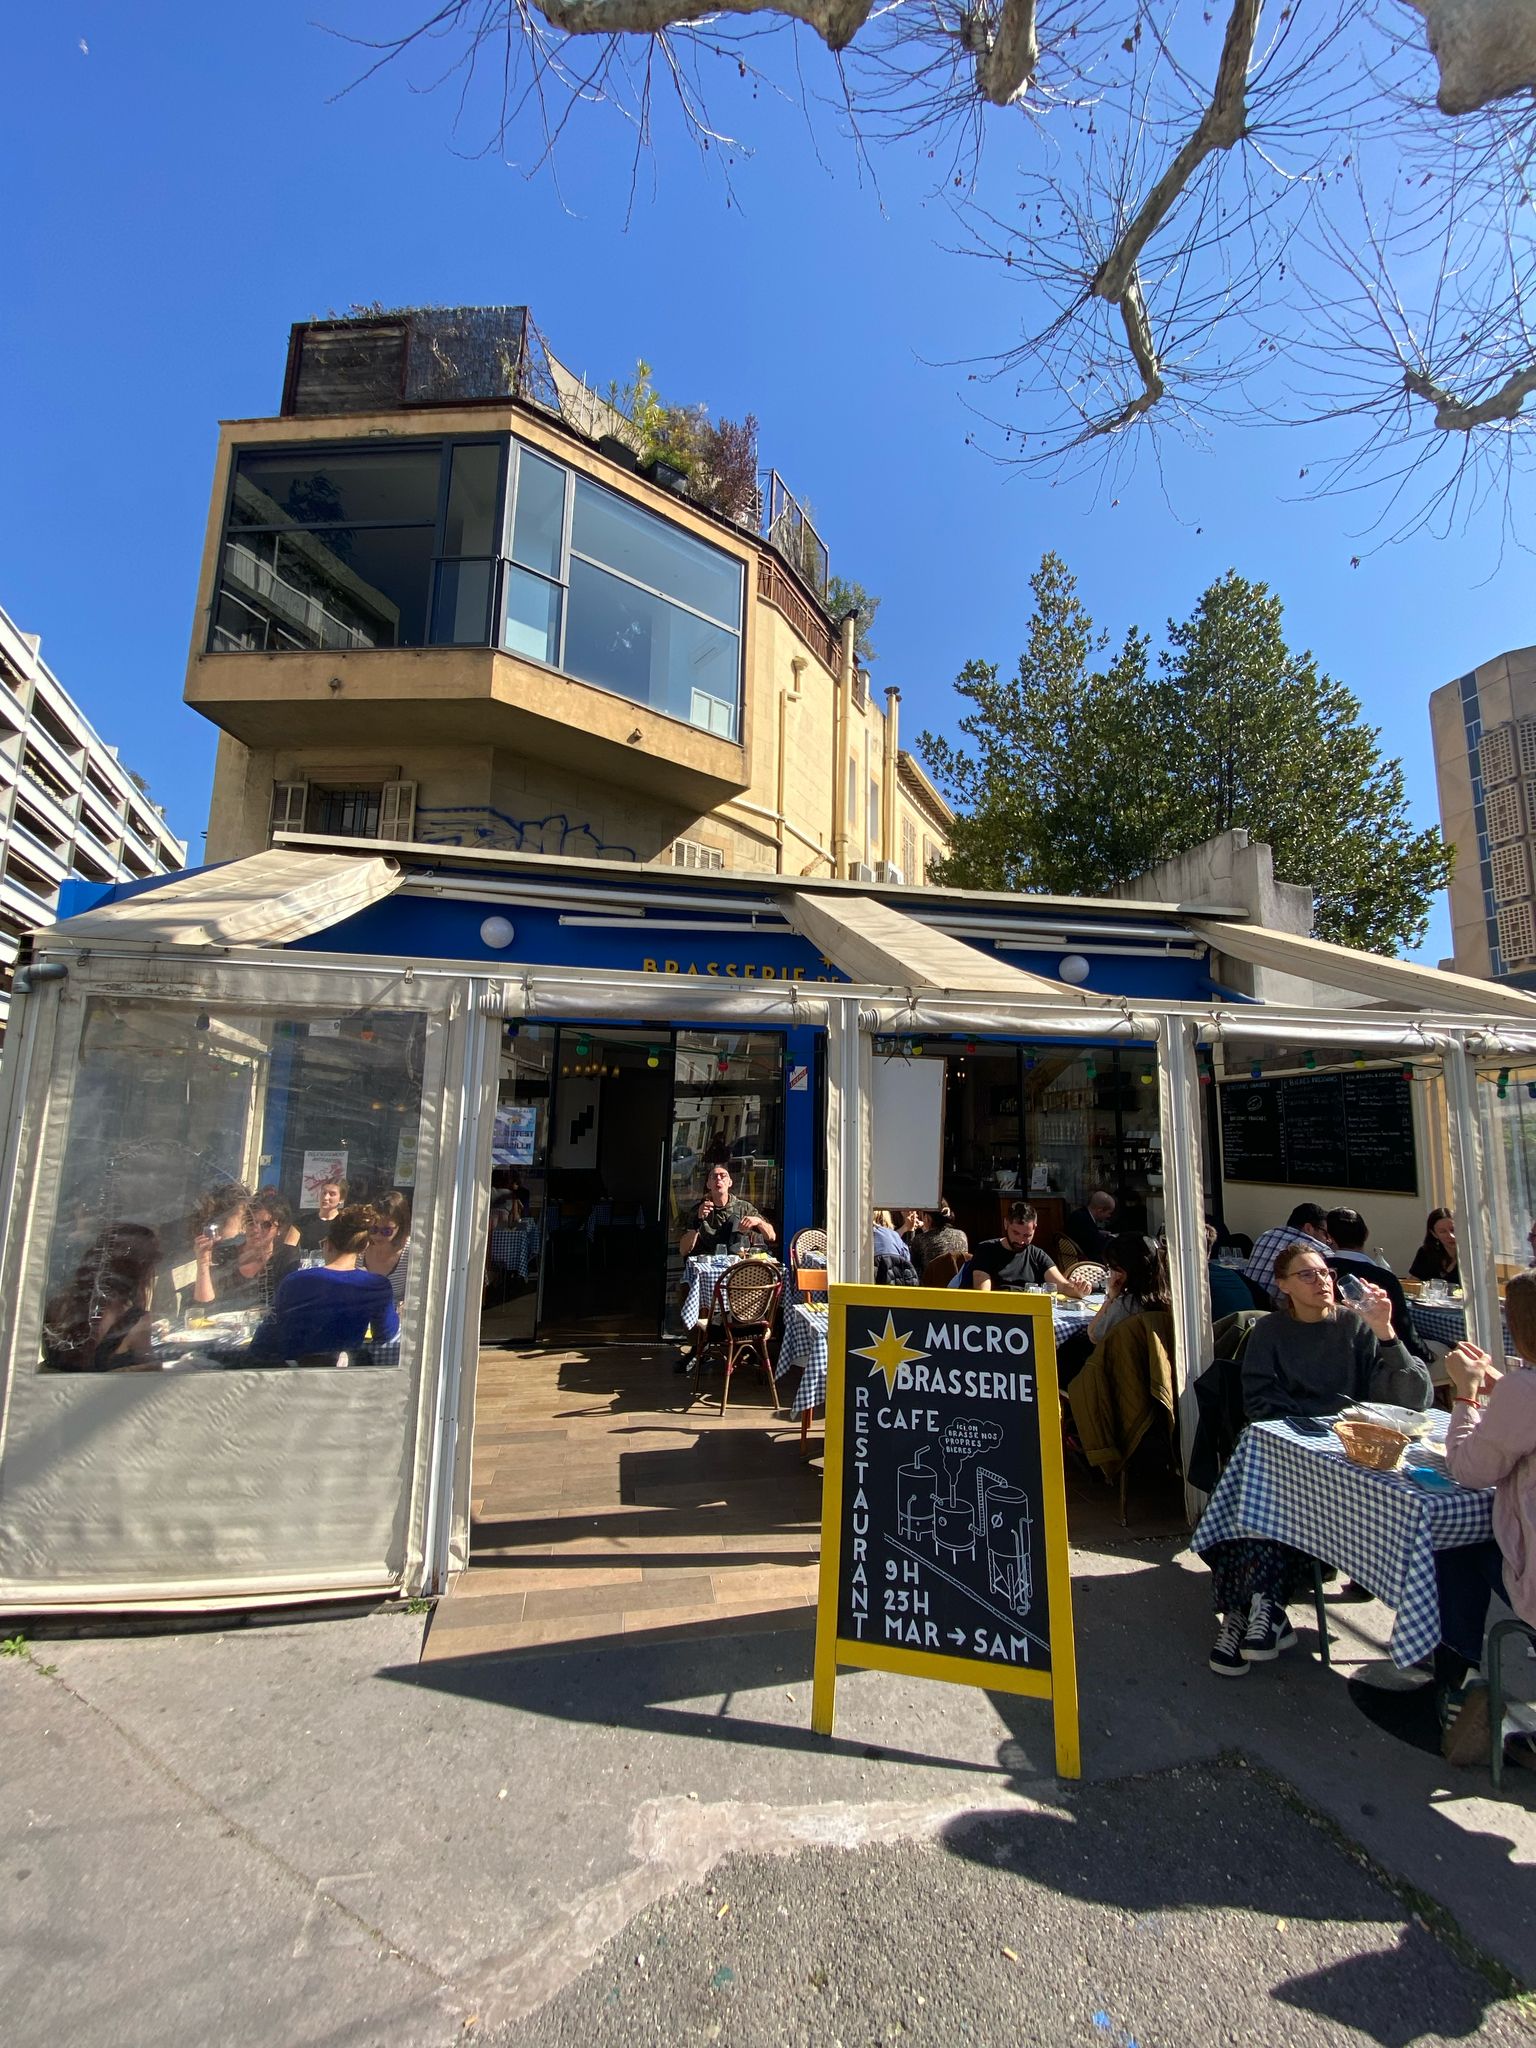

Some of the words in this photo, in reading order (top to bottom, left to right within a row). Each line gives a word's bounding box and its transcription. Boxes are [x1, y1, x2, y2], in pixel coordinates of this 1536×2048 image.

[925, 1322, 1029, 1355] MICRO
[897, 1362, 1033, 1402] BRASSERIE
[877, 1407, 940, 1433] CAFE
[945, 1437, 982, 1448] PROPRES
[948, 1430, 979, 1439] BRASSE
[981, 1432, 998, 1440] NOS
[945, 1445, 972, 1454] BIERES
[851, 1386, 870, 1639] RESTAURANT
[883, 1589, 929, 1616] 23H
[885, 1614, 940, 1647] MAR
[973, 1628, 1029, 1663] SAM
